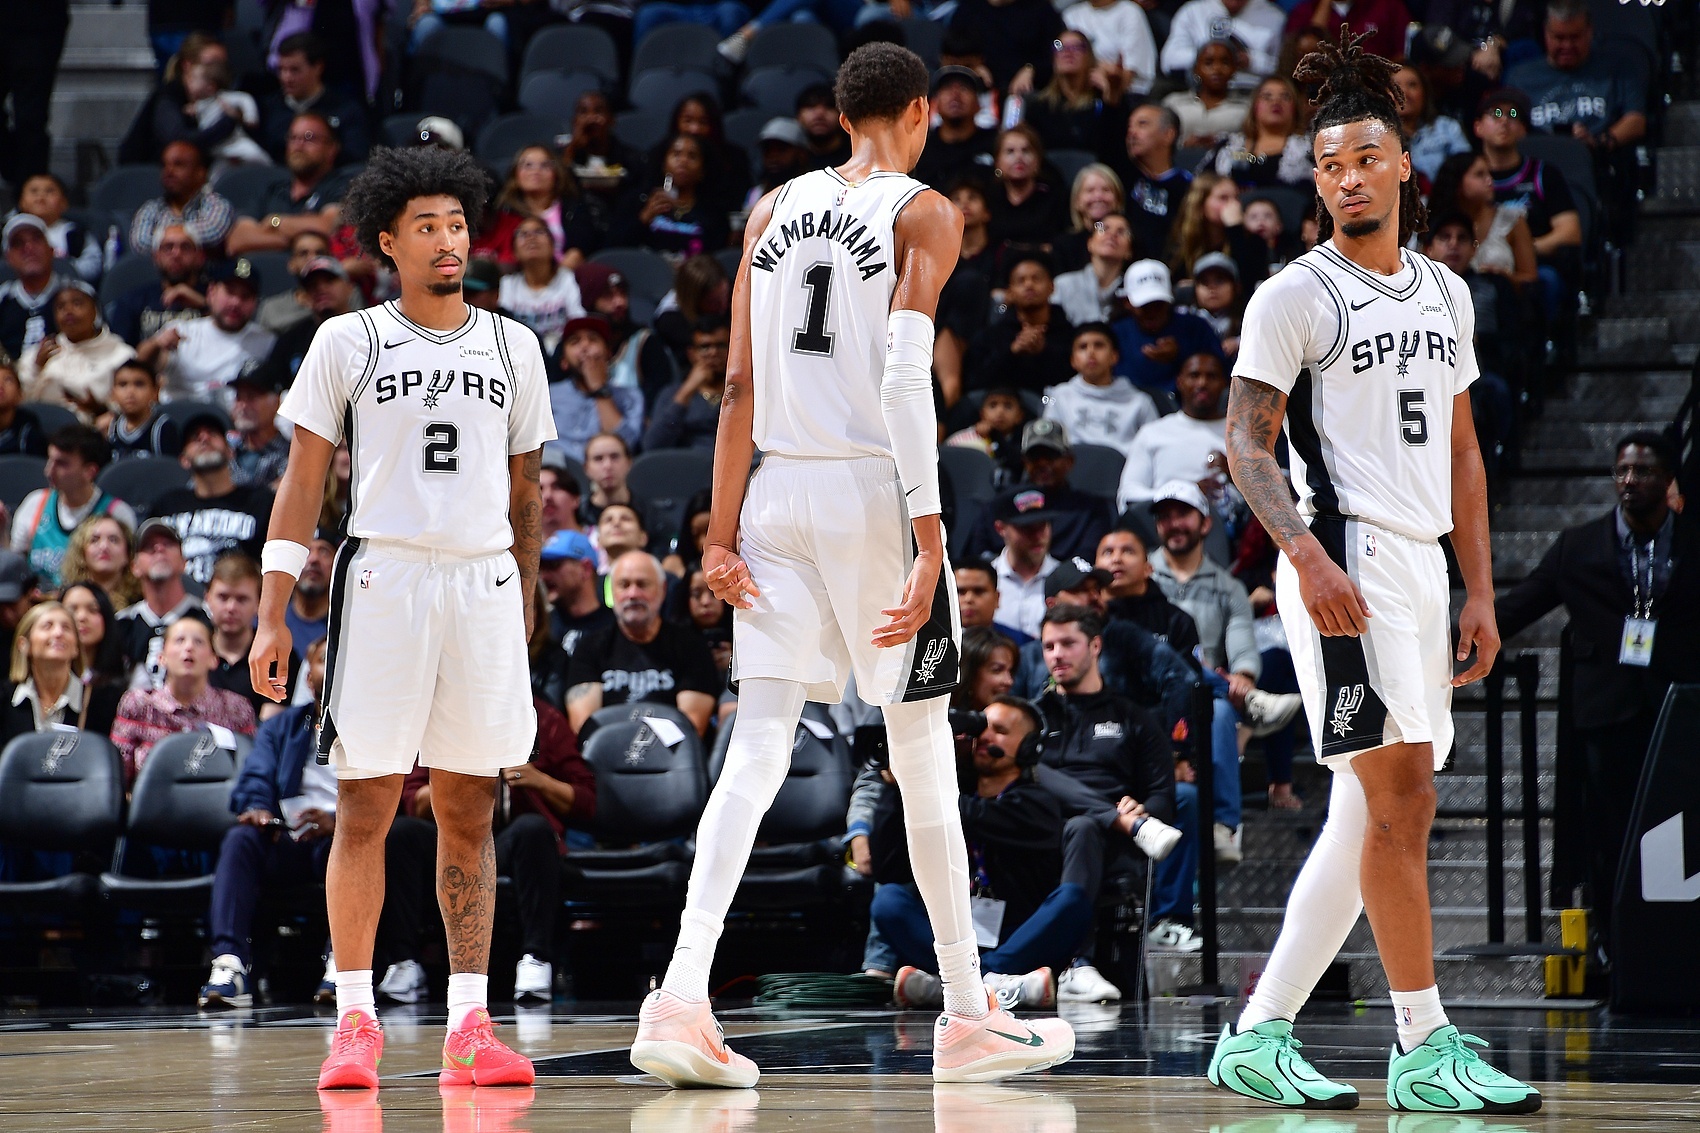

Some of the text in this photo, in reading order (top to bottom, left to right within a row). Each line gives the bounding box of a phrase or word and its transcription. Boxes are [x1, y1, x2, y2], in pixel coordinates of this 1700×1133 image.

[1530, 96, 1606, 126] SPURS
[790, 260, 836, 358] 1
[1351, 330, 1457, 379] SPURS
[376, 369, 507, 410] SPURS
[1397, 388, 1430, 447] 5
[422, 421, 460, 474] 2
[601, 668, 675, 704] SPURS
